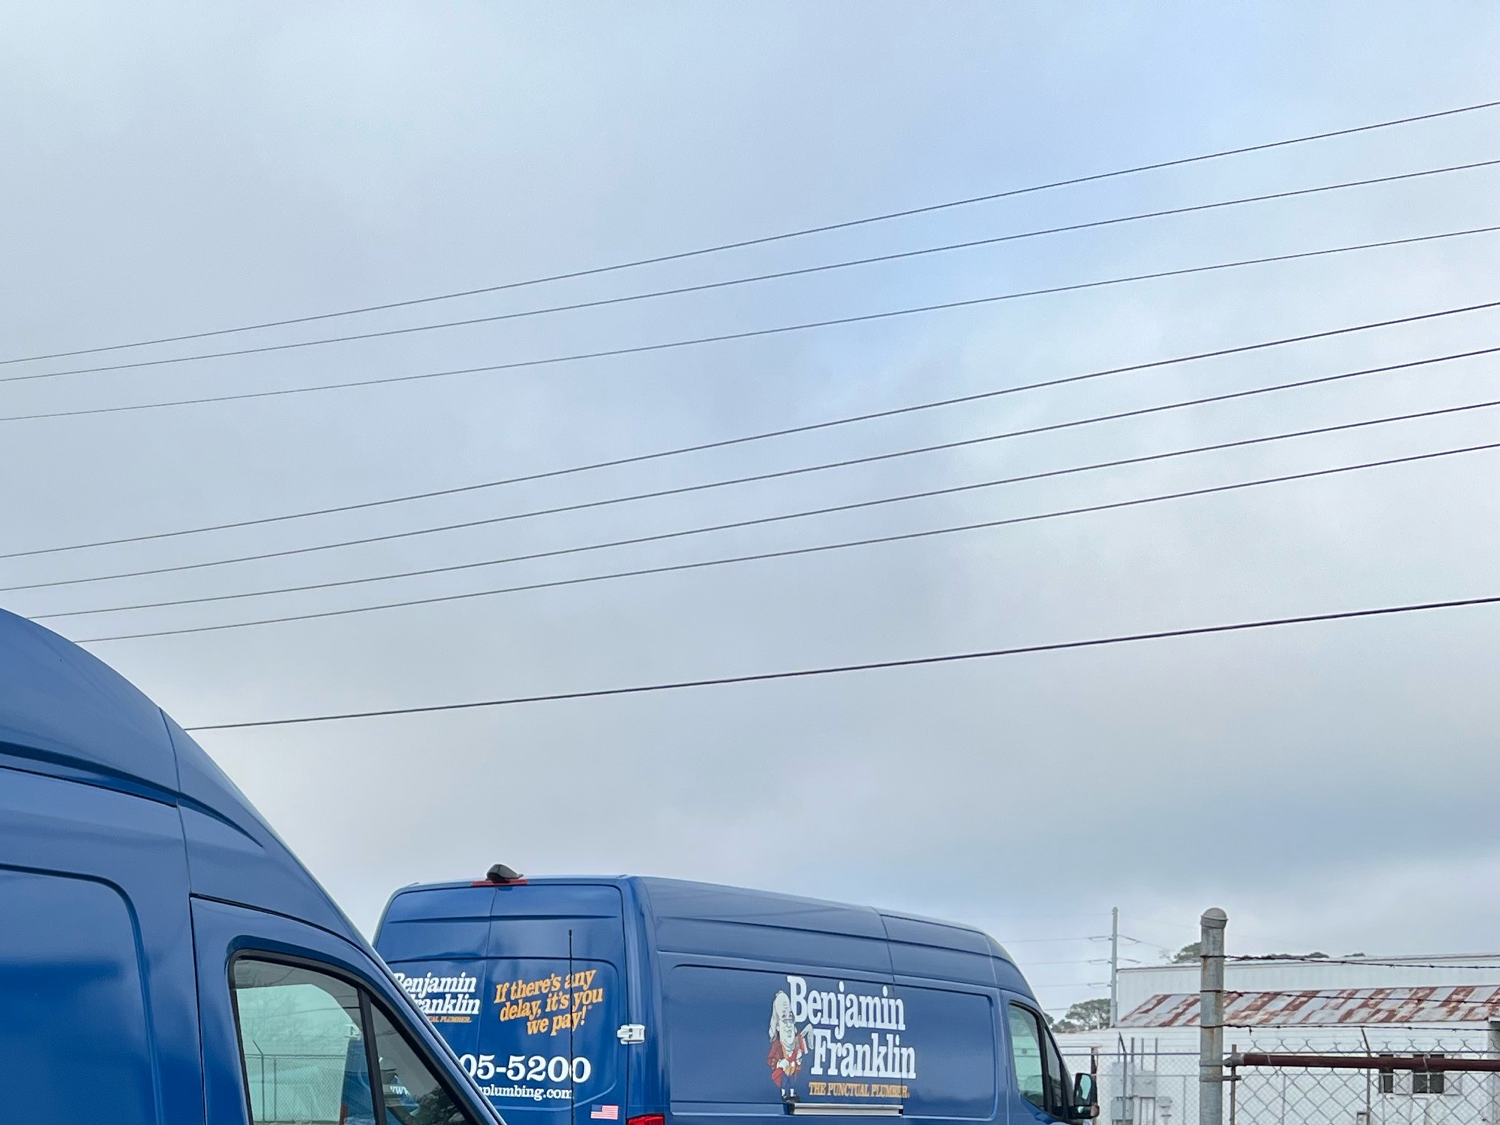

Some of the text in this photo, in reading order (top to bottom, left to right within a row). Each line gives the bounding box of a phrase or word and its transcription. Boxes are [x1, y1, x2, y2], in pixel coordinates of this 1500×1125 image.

[494, 969, 597, 1004] If there's any
[500, 988, 603, 1022] delay, it's you
[527, 1005, 587, 1036] we pay!
[787, 976, 906, 1040] Benjamin
[810, 1028, 917, 1080] Franklin
